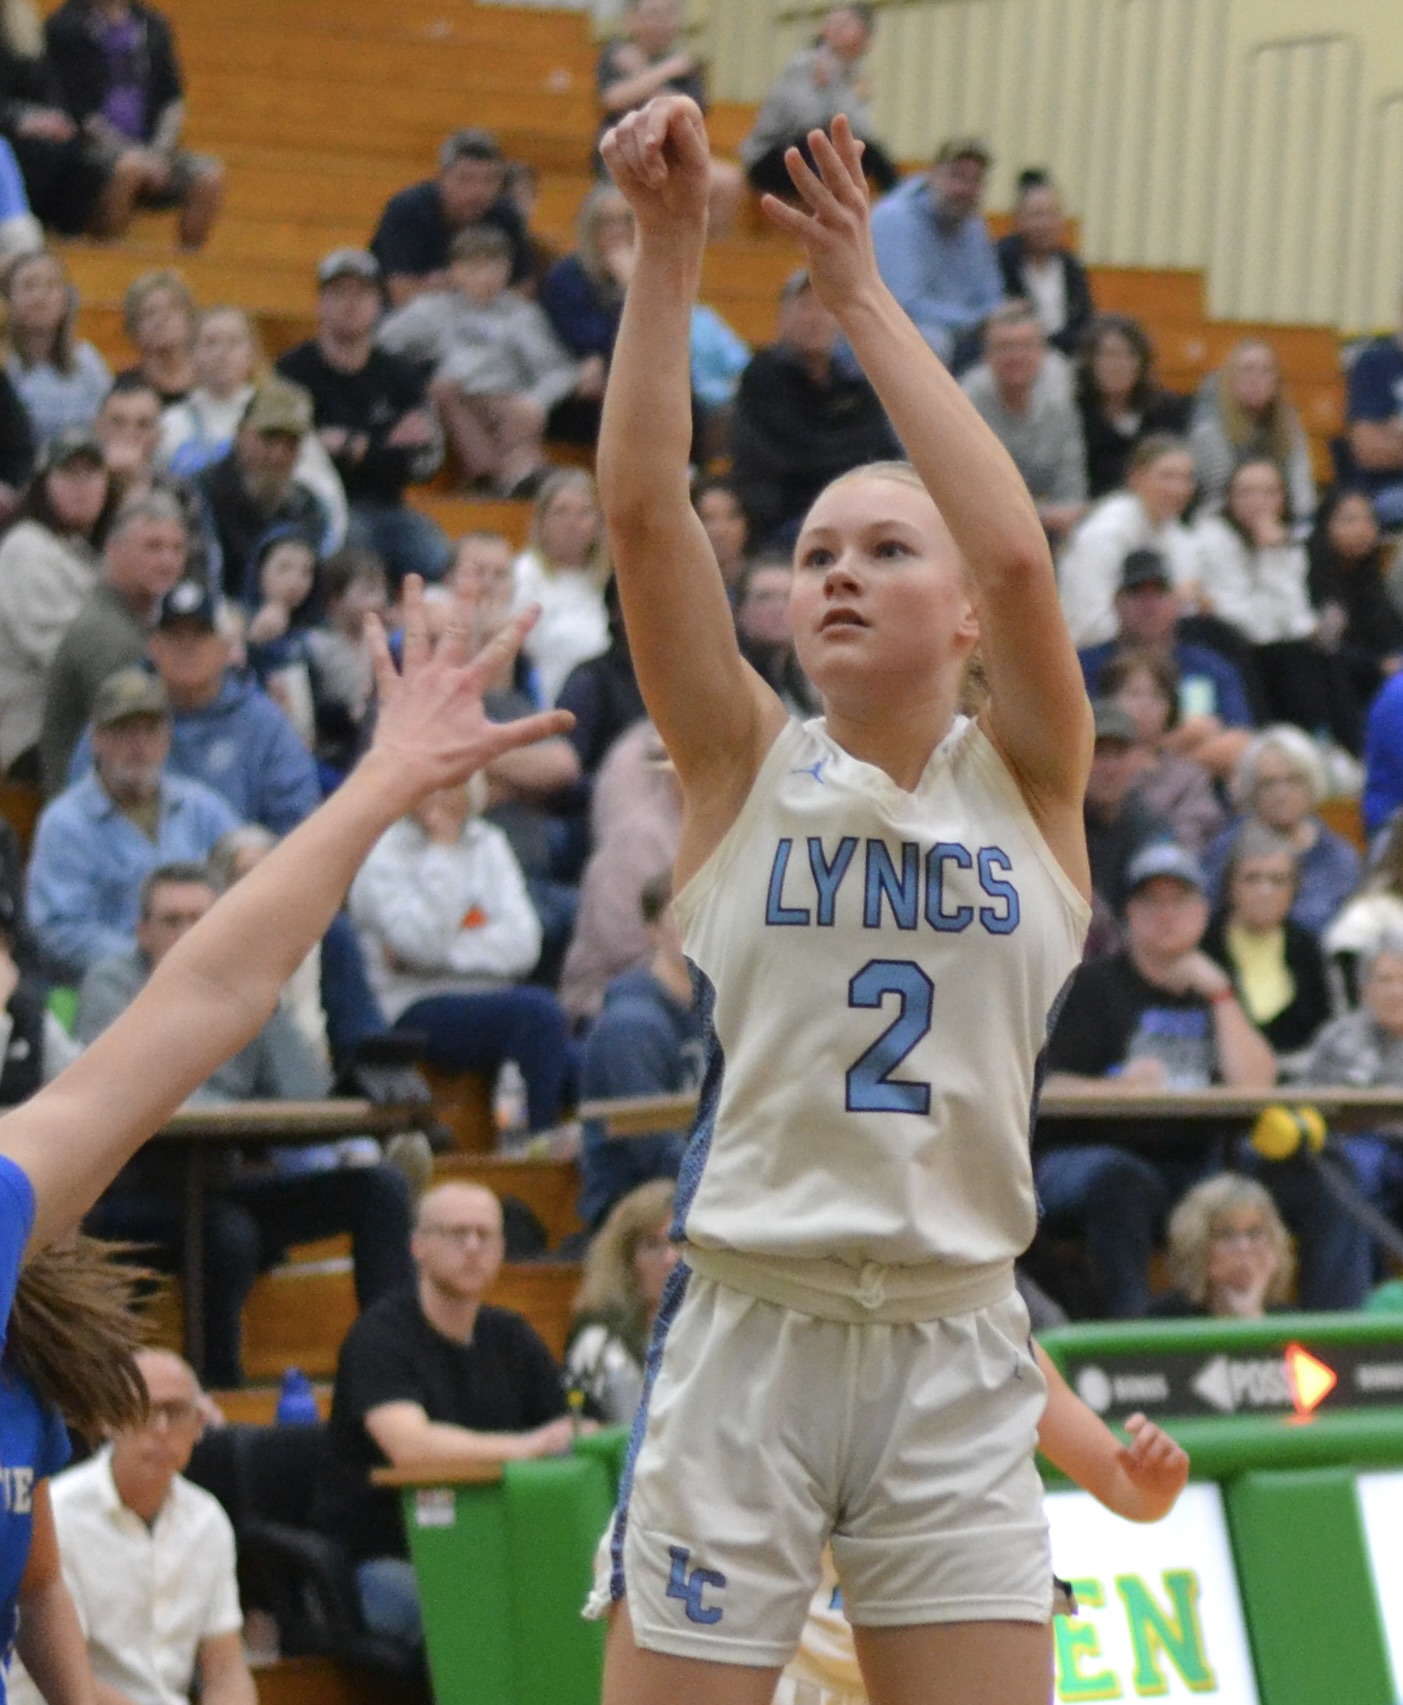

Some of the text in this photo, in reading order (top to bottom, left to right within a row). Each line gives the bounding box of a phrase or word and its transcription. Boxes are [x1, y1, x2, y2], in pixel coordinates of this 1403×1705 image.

[765, 836, 1020, 935] LYNCS
[845, 959, 935, 1115] 2
[666, 1545, 726, 1625] LC
